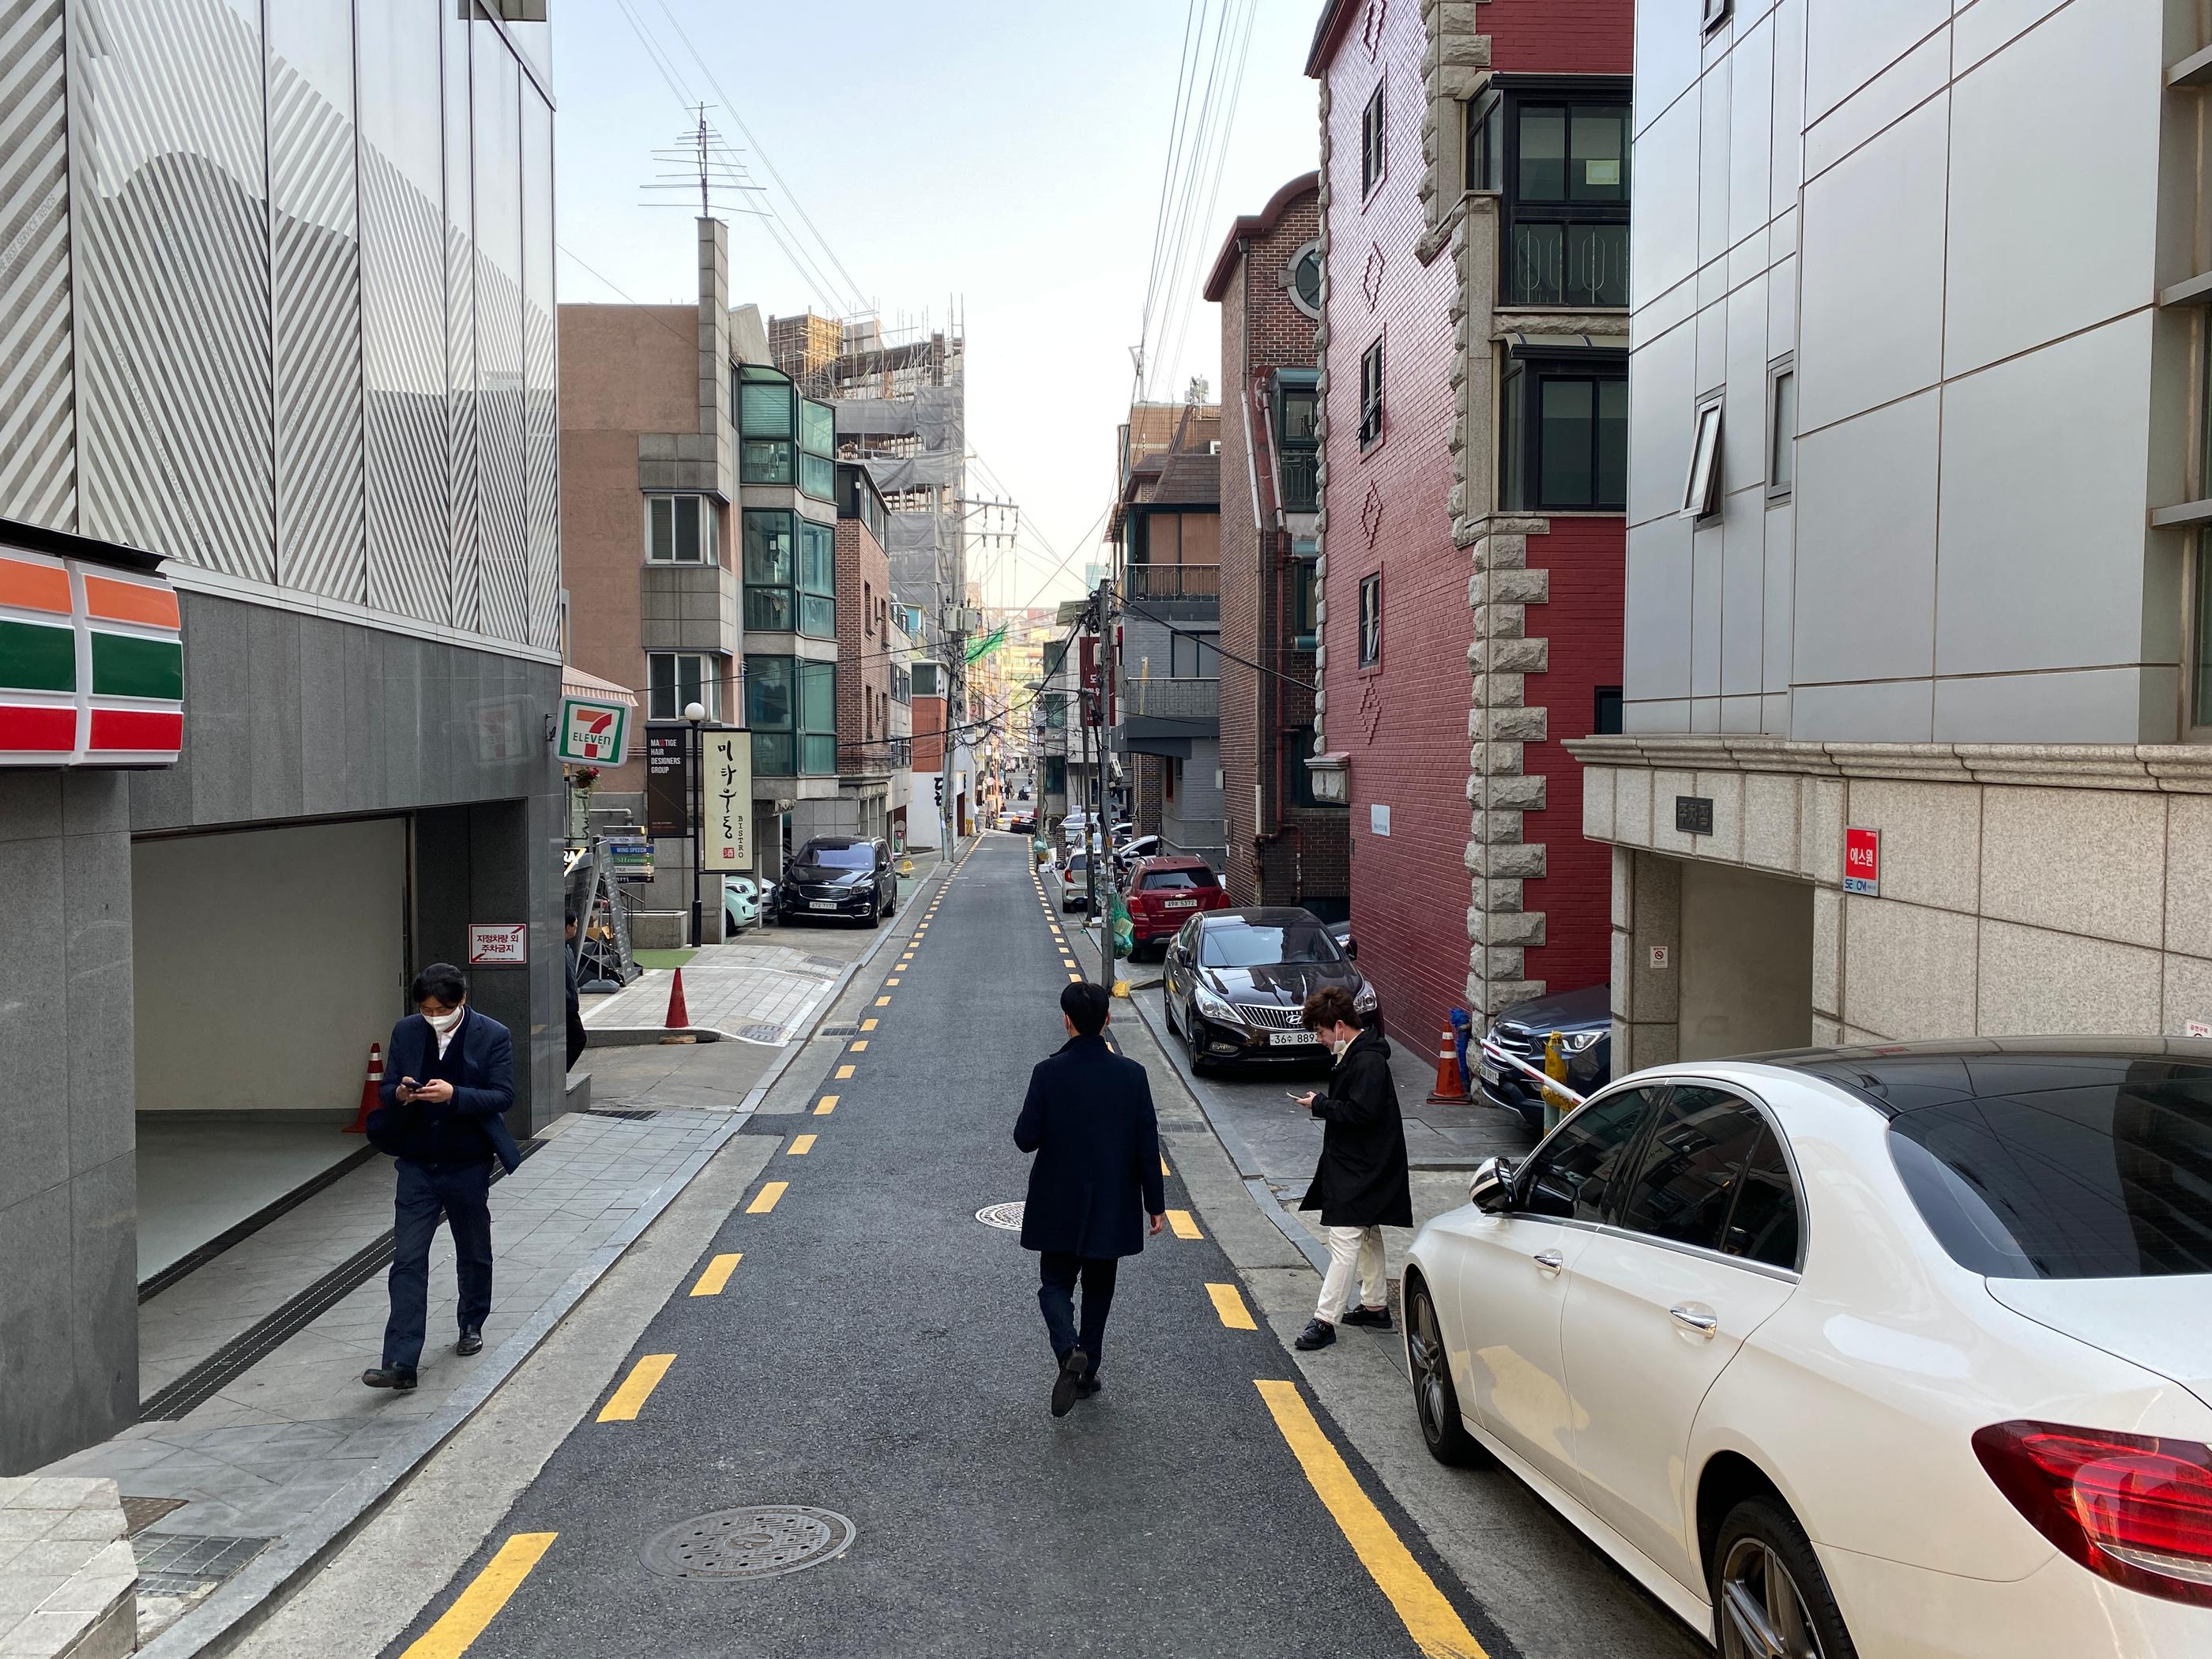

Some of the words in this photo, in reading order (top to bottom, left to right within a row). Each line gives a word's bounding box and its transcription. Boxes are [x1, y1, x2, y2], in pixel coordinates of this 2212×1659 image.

[17, 216, 39, 248] SERVICE
[577, 709, 612, 758] 7
[1849, 847, 1874, 867] 에스원
[476, 934, 509, 942] 지정차량
[510, 934, 519, 942] 외
[481, 944, 514, 953] 주차금지
[1274, 1035, 1293, 1044] 36수
